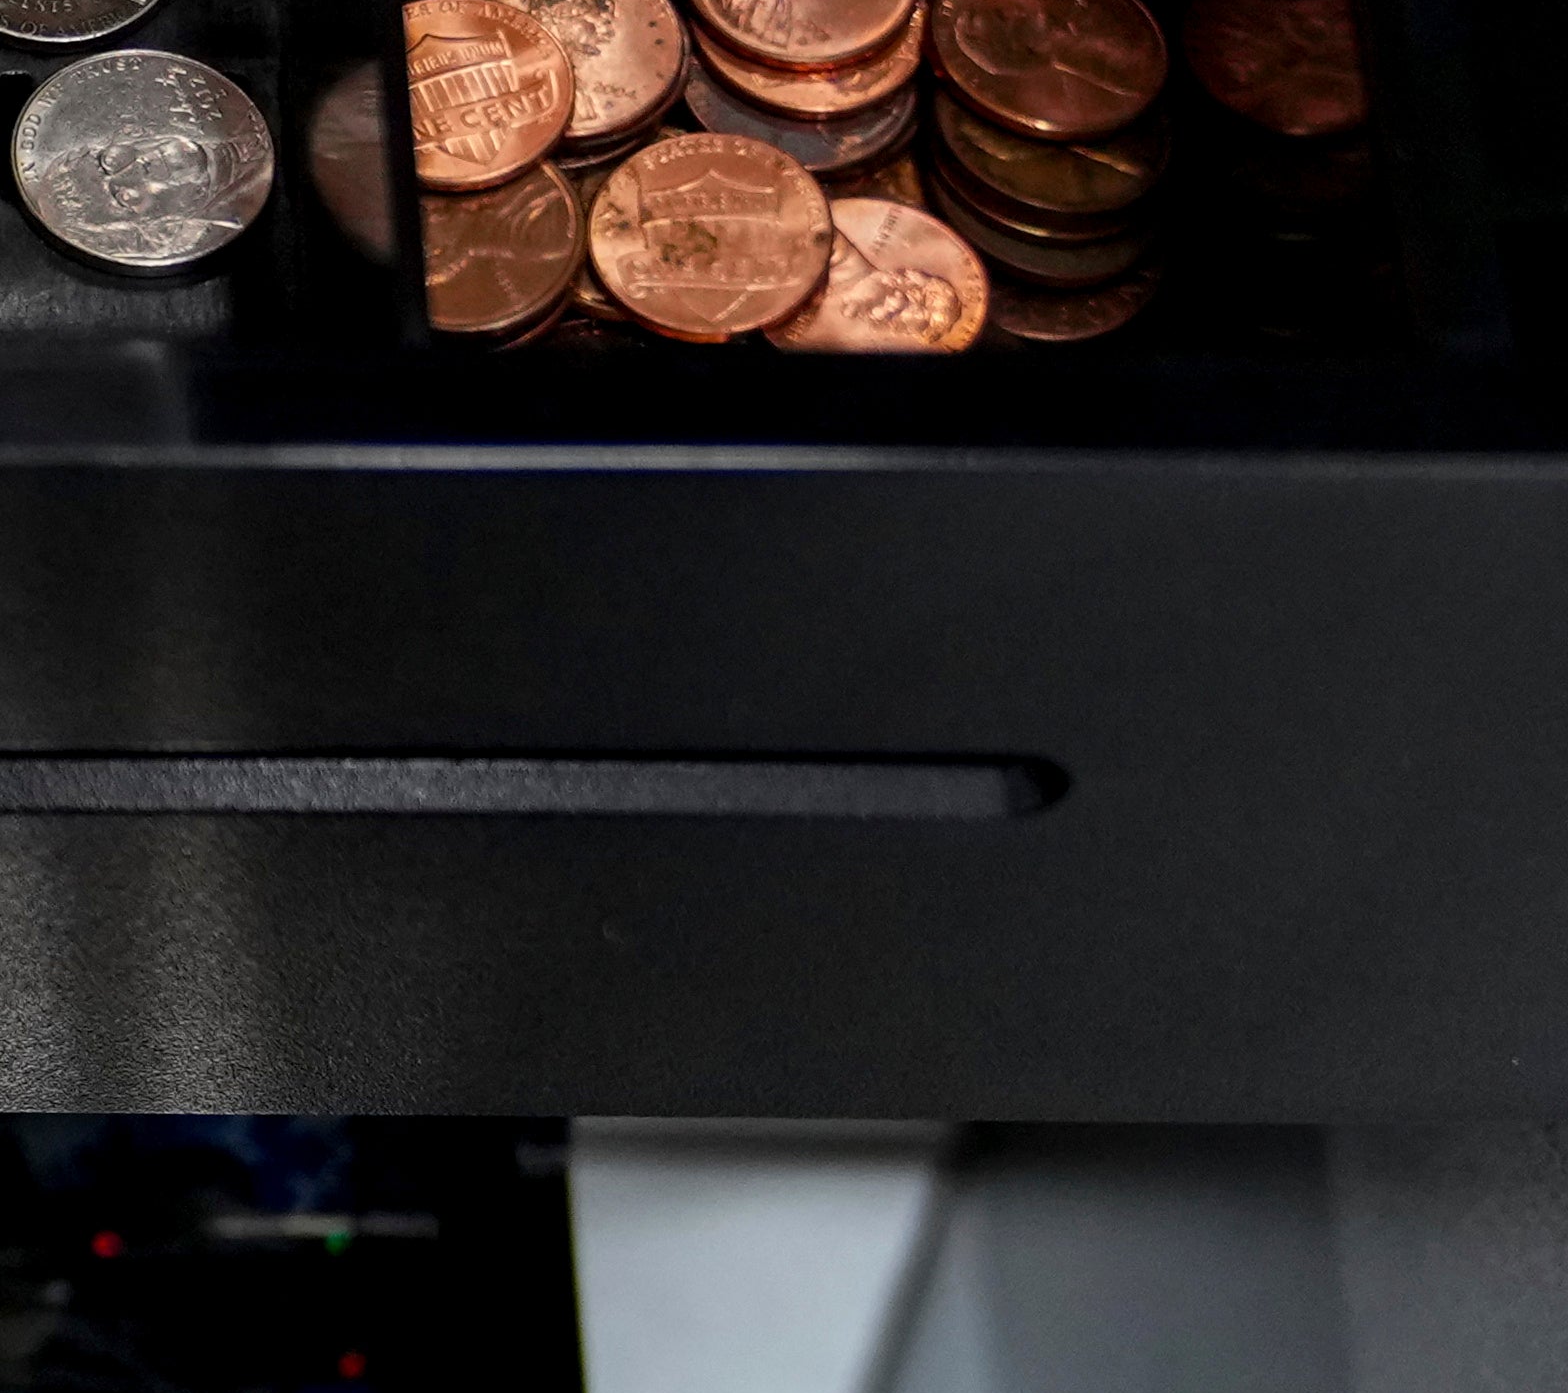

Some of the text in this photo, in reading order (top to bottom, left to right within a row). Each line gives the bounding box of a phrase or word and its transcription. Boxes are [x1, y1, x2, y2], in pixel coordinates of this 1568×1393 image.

[439, 0, 466, 17] OF
[18, 18, 50, 37] OF
[19, 55, 143, 185] IN GOD WE TRUST
[412, 86, 554, 141] NE CENT
